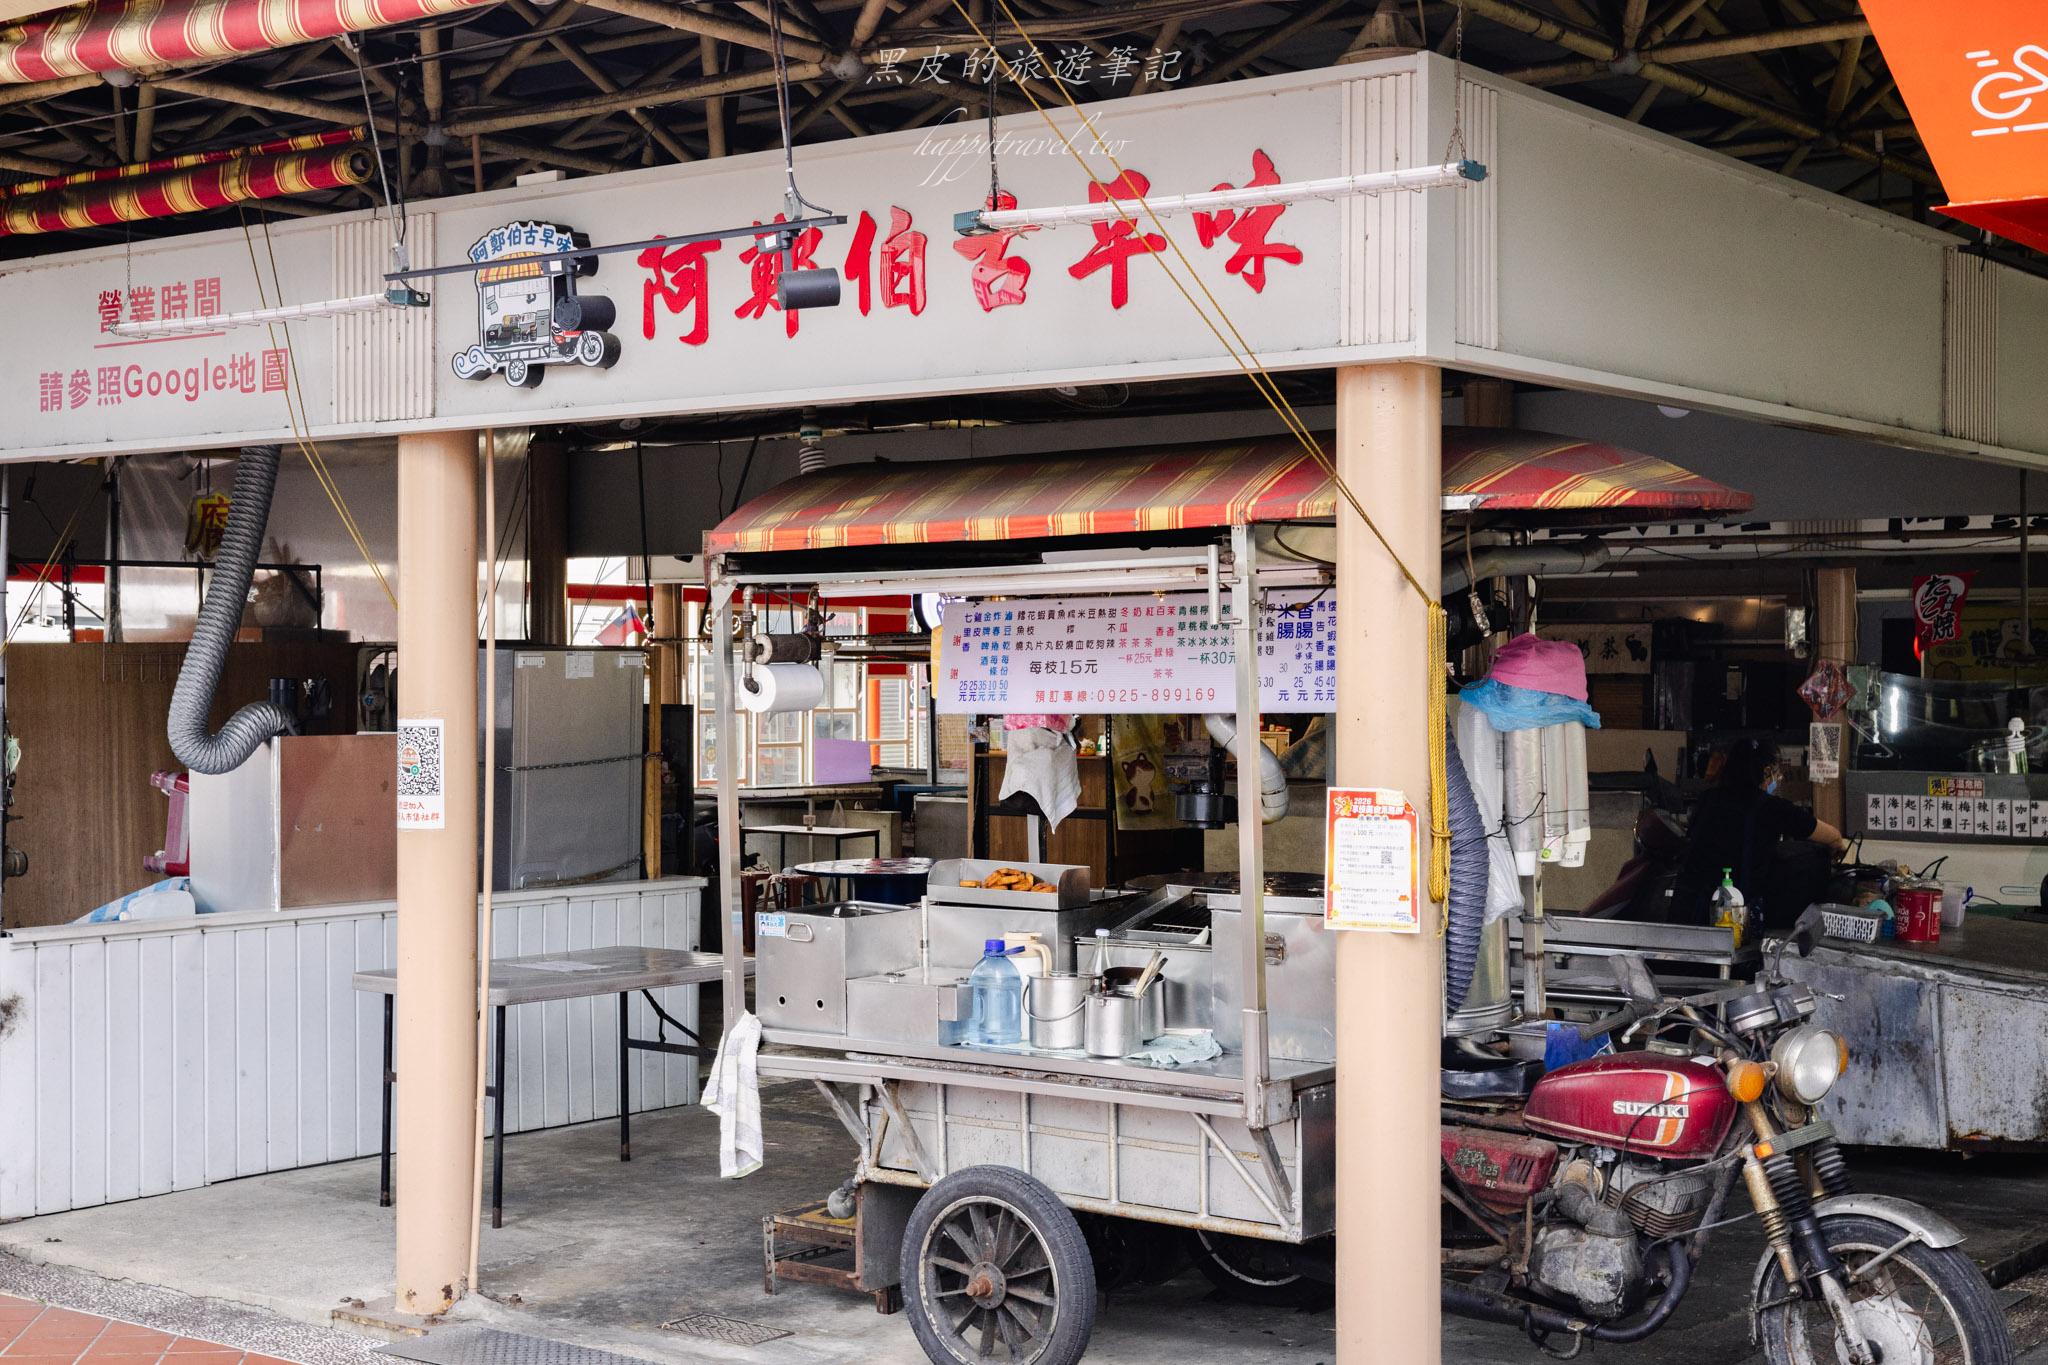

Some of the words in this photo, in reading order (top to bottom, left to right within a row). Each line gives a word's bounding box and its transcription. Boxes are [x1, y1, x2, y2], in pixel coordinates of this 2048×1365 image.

[471, 224, 572, 263] 阿鄭伯古早味
[636, 148, 1304, 347] 阿鄭伯古早味
[97, 276, 222, 334] 營業時間
[39, 347, 290, 413] 請參照Google地圖
[1029, 659, 1099, 675] 每枝15元
[1869, 797, 1883, 828] 原味
[1886, 797, 1900, 829] 海苔
[1904, 798, 1918, 829] 起司
[1958, 801, 1972, 831] 梅子
[2015, 806, 2029, 834] 咖哩
[1613, 1100, 1689, 1118] SUZUKI
